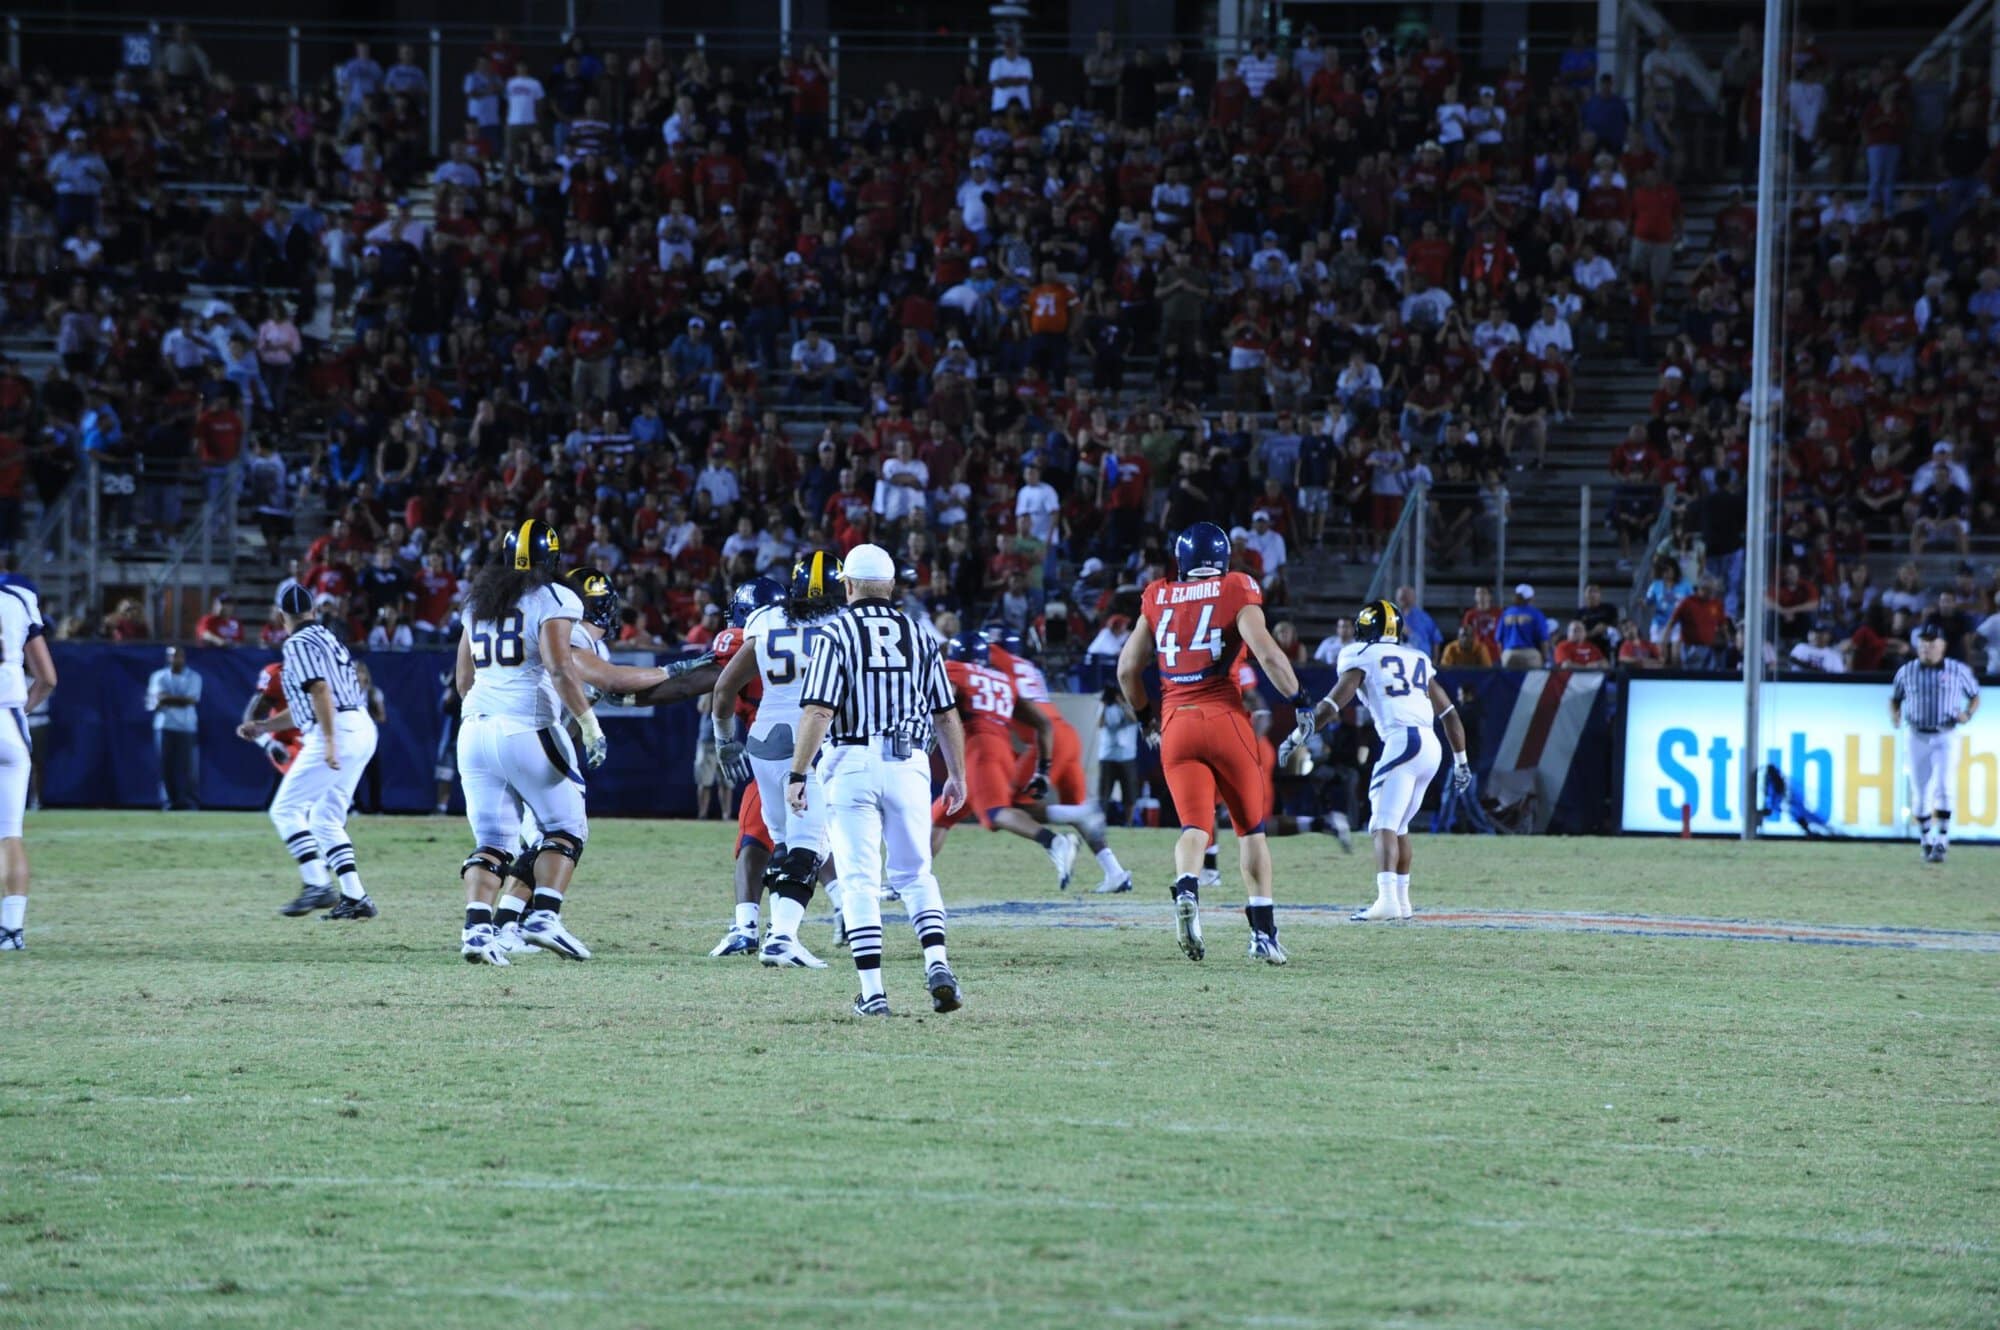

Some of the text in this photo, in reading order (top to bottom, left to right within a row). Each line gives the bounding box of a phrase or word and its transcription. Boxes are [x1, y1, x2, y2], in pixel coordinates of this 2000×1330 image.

[128, 38, 151, 65] 26
[104, 473, 136, 495] 26
[1171, 581, 1221, 604] ELMORE
[471, 607, 524, 669] 58
[862, 616, 907, 669] R
[1154, 604, 1226, 668] 44
[968, 673, 1014, 719] 33
[1380, 656, 1428, 698] 34
[1656, 727, 1998, 827] StbHb
